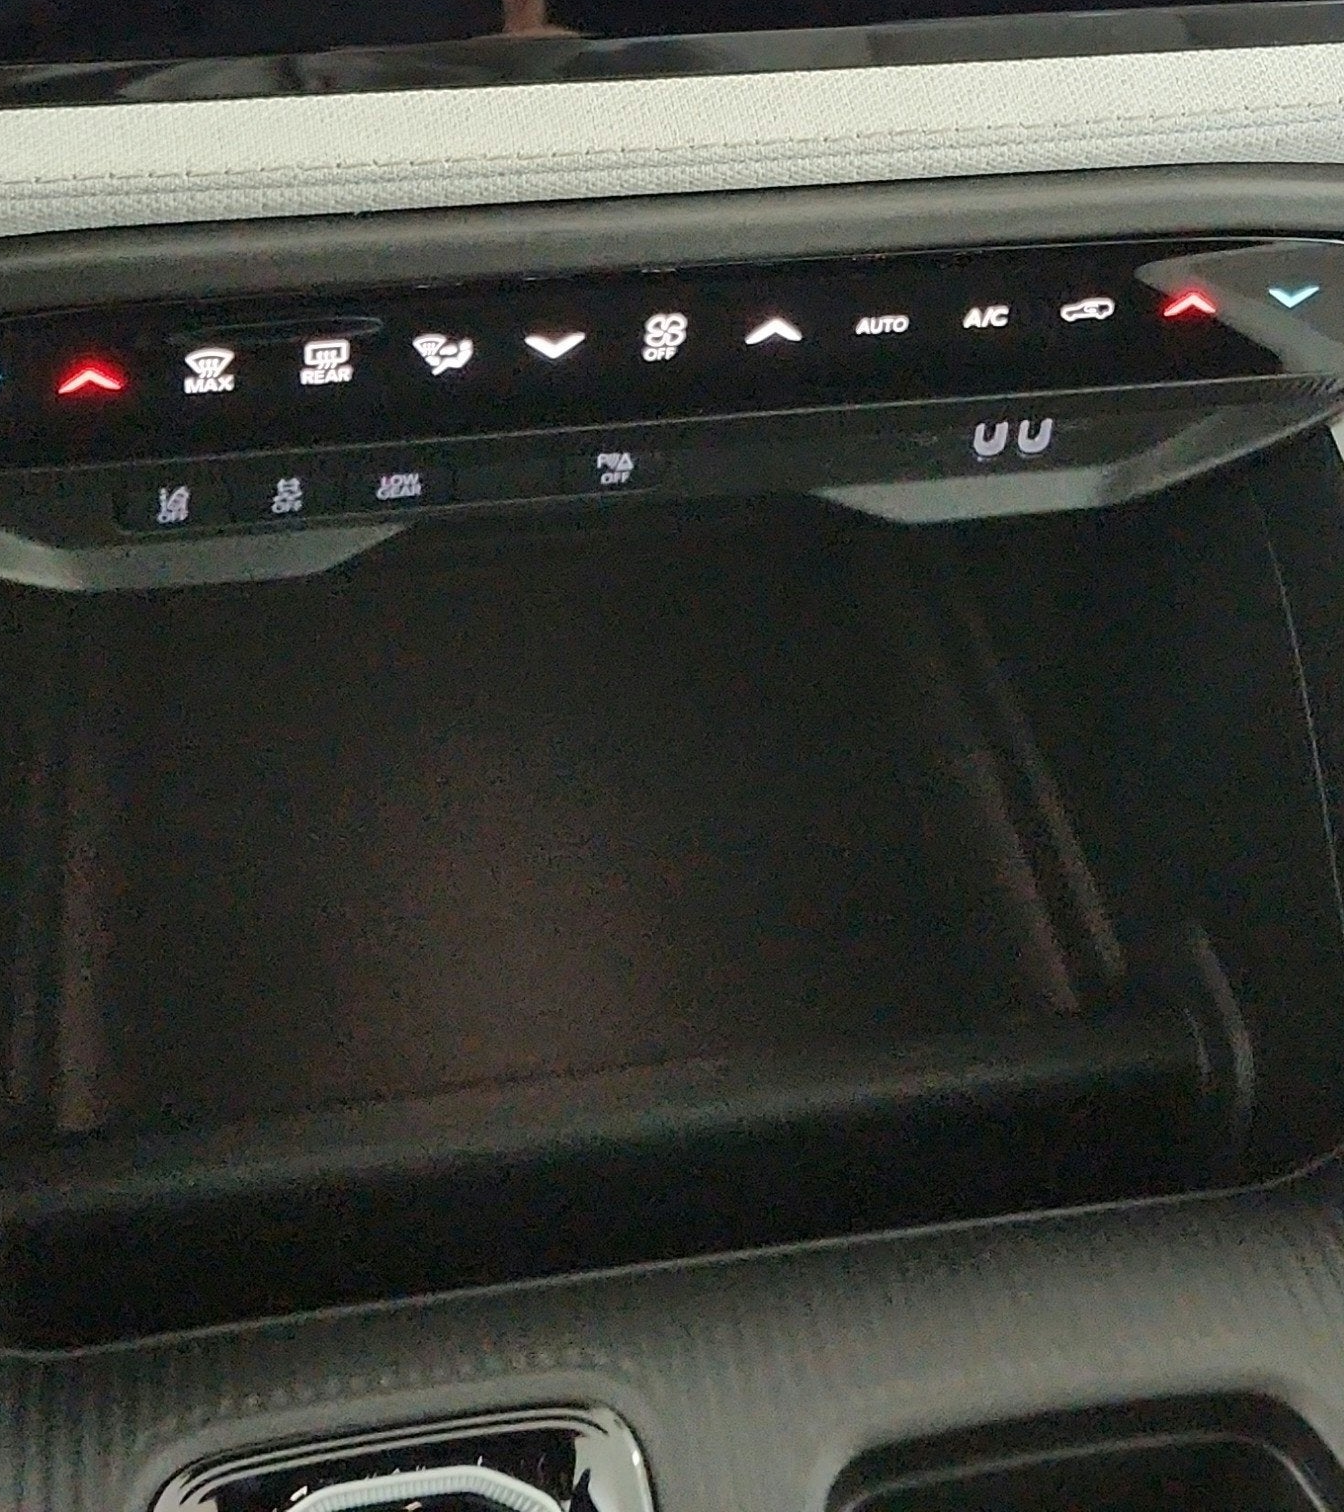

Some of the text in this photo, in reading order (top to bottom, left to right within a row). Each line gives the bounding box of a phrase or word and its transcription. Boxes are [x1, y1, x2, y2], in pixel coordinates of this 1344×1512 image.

[855, 314, 911, 337] AUTO
[962, 304, 1010, 330] A/C
[641, 344, 678, 362] OFF
[183, 373, 235, 394] MAX
[299, 363, 354, 386] REAR
[380, 472, 420, 488] LOW
[600, 470, 631, 485] OFF
[375, 483, 422, 501] GEAR
